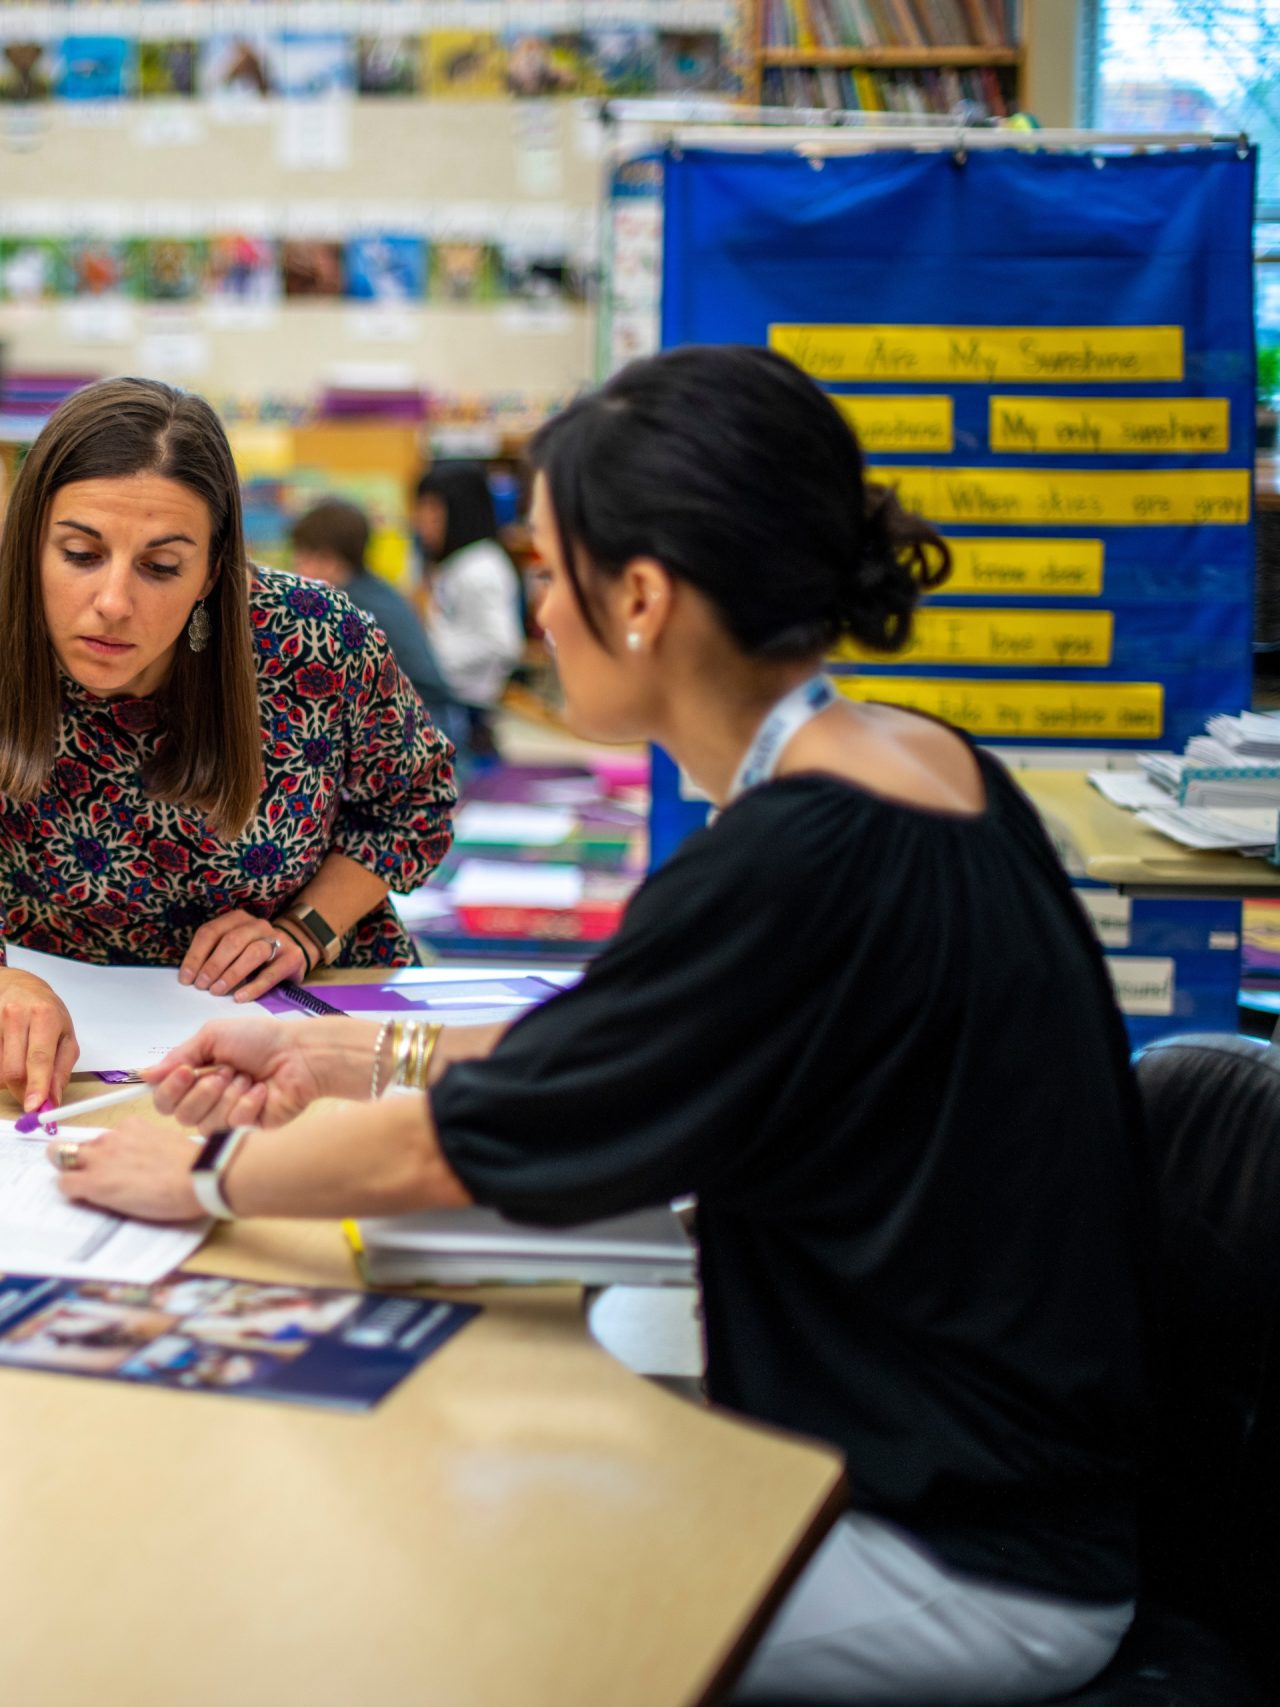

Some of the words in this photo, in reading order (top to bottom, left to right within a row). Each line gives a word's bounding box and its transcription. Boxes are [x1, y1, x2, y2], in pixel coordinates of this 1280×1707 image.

[866, 335, 918, 373] Are
[946, 335, 998, 383] My
[1019, 336, 1141, 374] Sunshine
[999, 409, 1039, 452] My
[1054, 413, 1101, 452] only
[947, 481, 1019, 516] When
[1131, 493, 1171, 514] are
[946, 618, 963, 655] I
